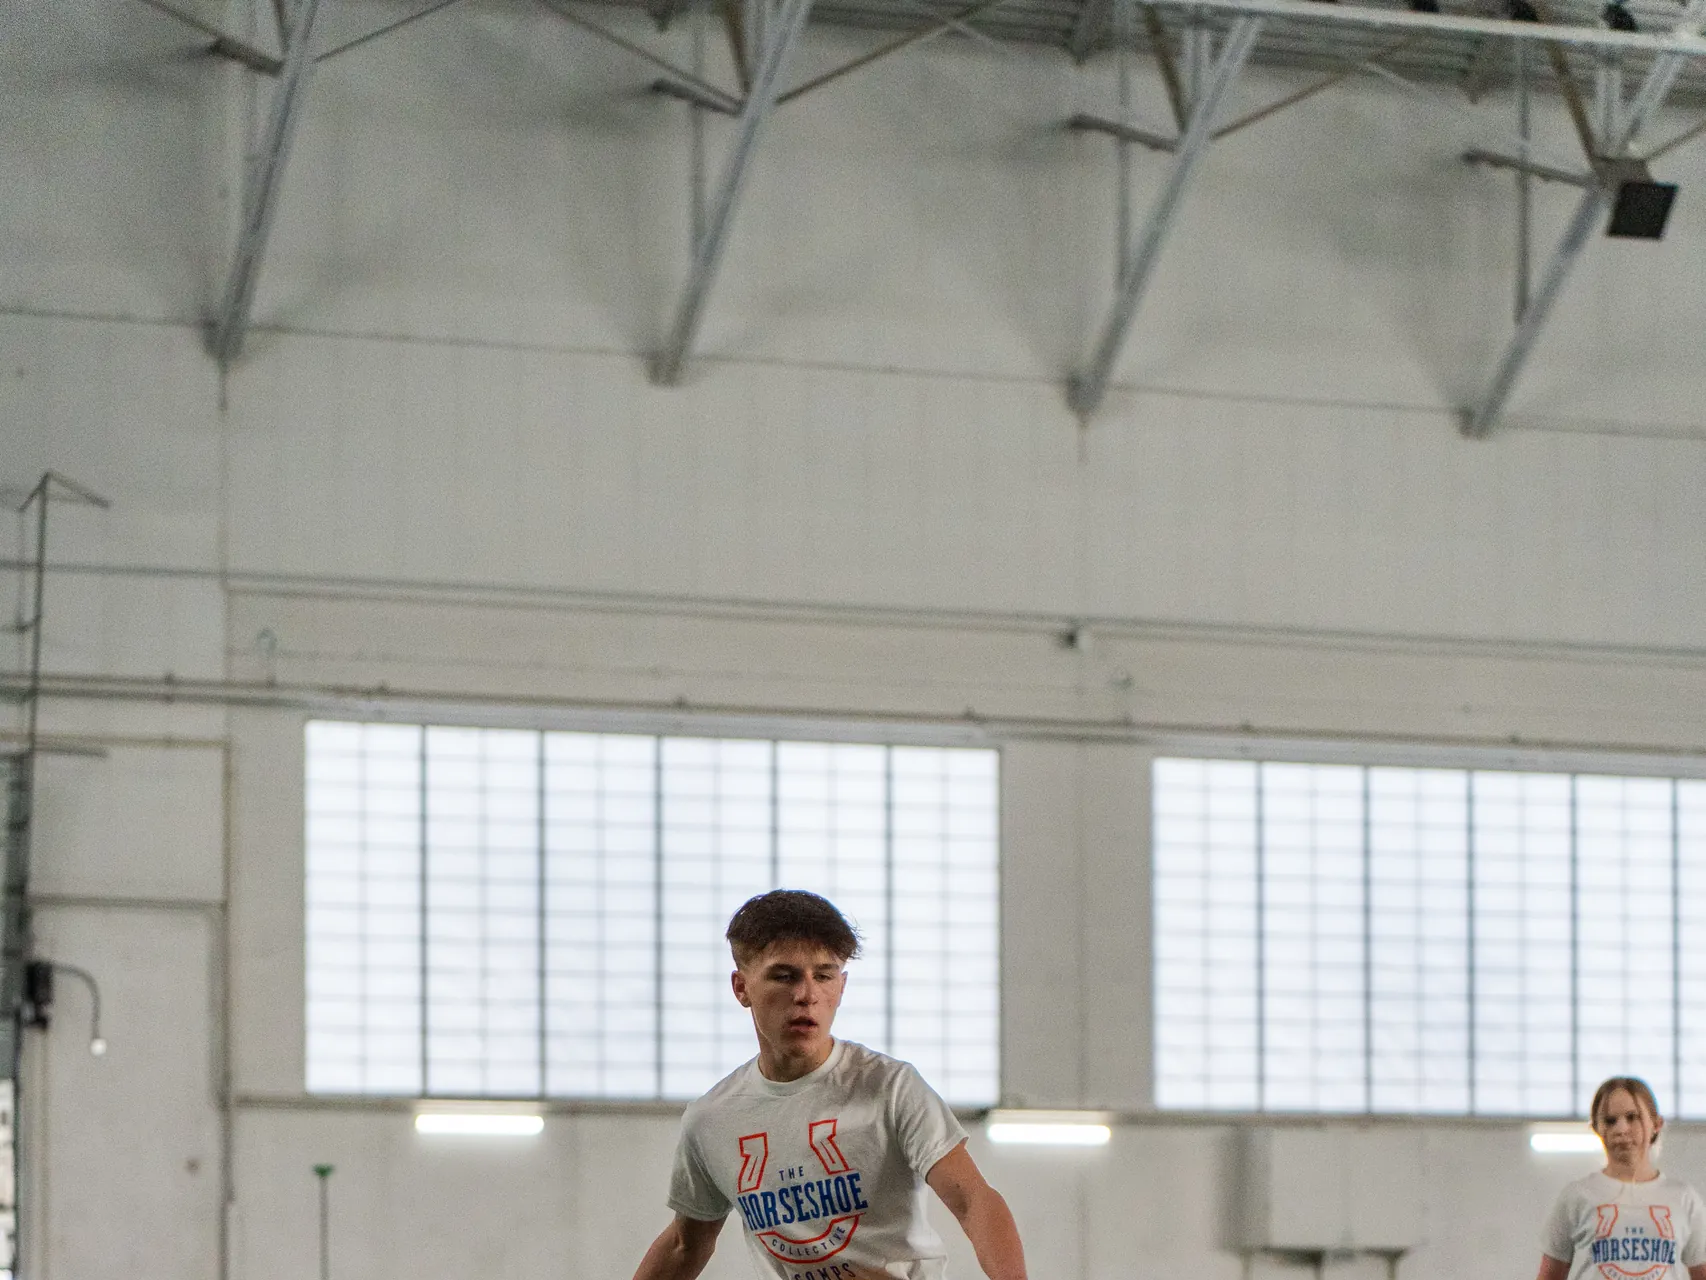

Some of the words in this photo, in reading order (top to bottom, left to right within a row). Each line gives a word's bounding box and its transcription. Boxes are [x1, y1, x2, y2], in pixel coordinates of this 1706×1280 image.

[779, 1166, 804, 1181] THE
[738, 1173, 868, 1231] HORSESHOE
[772, 1226, 845, 1256] COLLECTIVE
[1592, 1237, 1676, 1264] HORSESHOE
